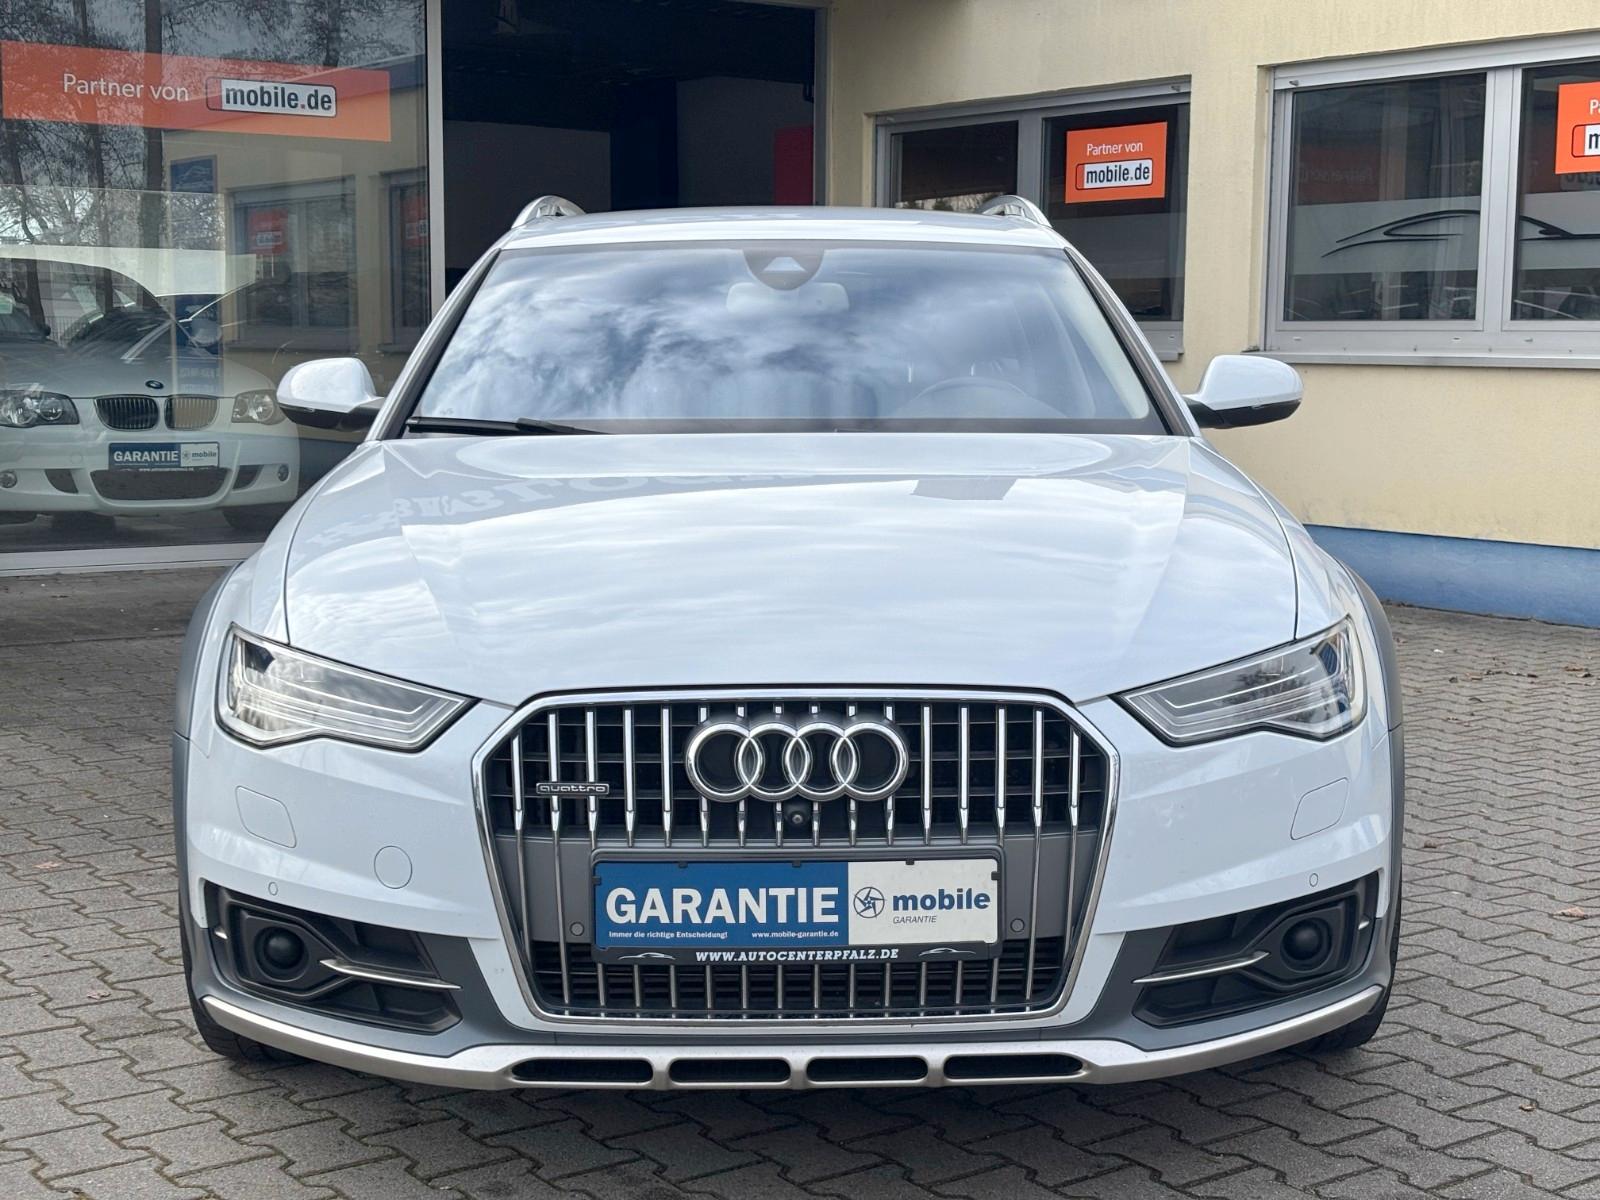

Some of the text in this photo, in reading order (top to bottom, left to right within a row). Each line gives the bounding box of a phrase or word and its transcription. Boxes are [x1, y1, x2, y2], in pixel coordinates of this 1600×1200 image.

[63, 73, 332, 111] Partner von mobile.de
[1086, 142, 1143, 156] Partner von
[1086, 163, 1150, 184] mobile.de
[113, 450, 179, 462] GARANTIE
[191, 450, 217, 458] mobile
[605, 887, 839, 924] GARANTIE
[893, 887, 991, 911] mobile
[893, 915, 937, 924] GARANTIE
[647, 931, 674, 939] richtige
[676, 931, 728, 939] Entscheidung!
[752, 930, 839, 939] www.mobile-garantie.de
[696, 948, 899, 962] WWW.AUTOCENTERPFALZ.DE
